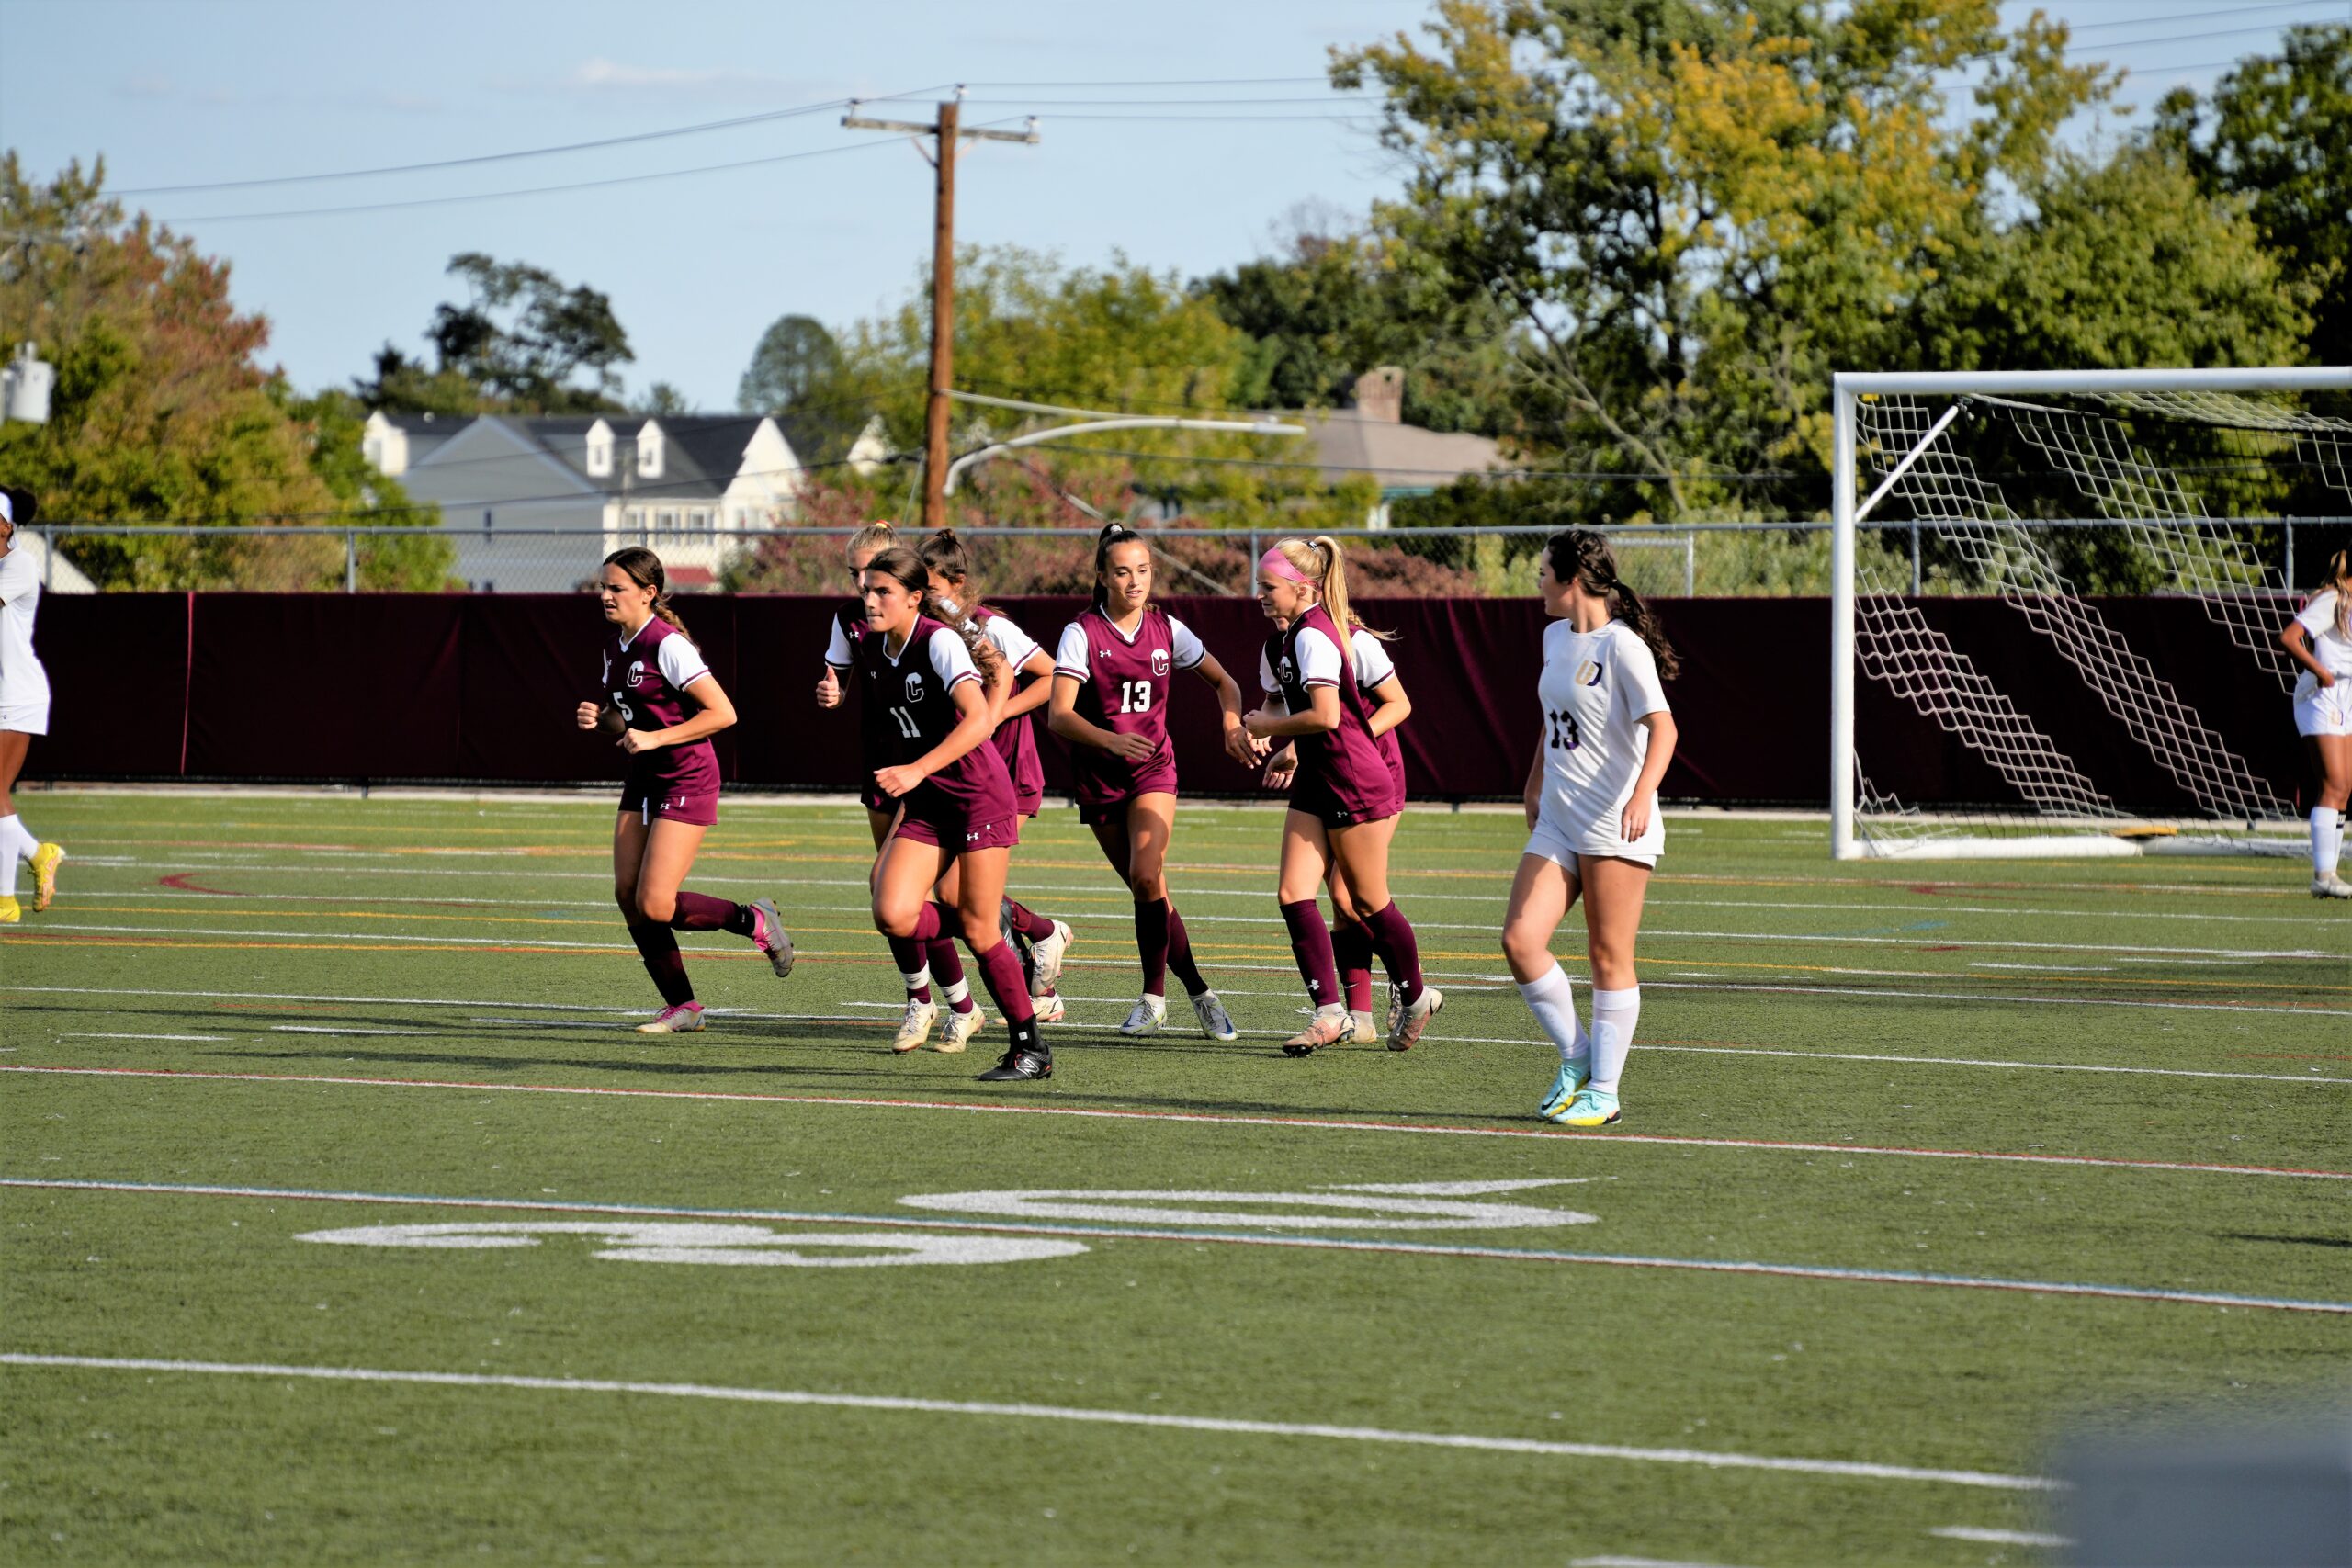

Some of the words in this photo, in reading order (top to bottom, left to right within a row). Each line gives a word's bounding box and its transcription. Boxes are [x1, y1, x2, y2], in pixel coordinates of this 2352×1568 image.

[626, 660, 645, 688] C
[1150, 648, 1170, 677] C
[905, 671, 924, 703] C
[1120, 680, 1151, 714] 13
[613, 691, 634, 722] 5
[889, 705, 922, 739] 11
[1548, 708, 1580, 750] 13
